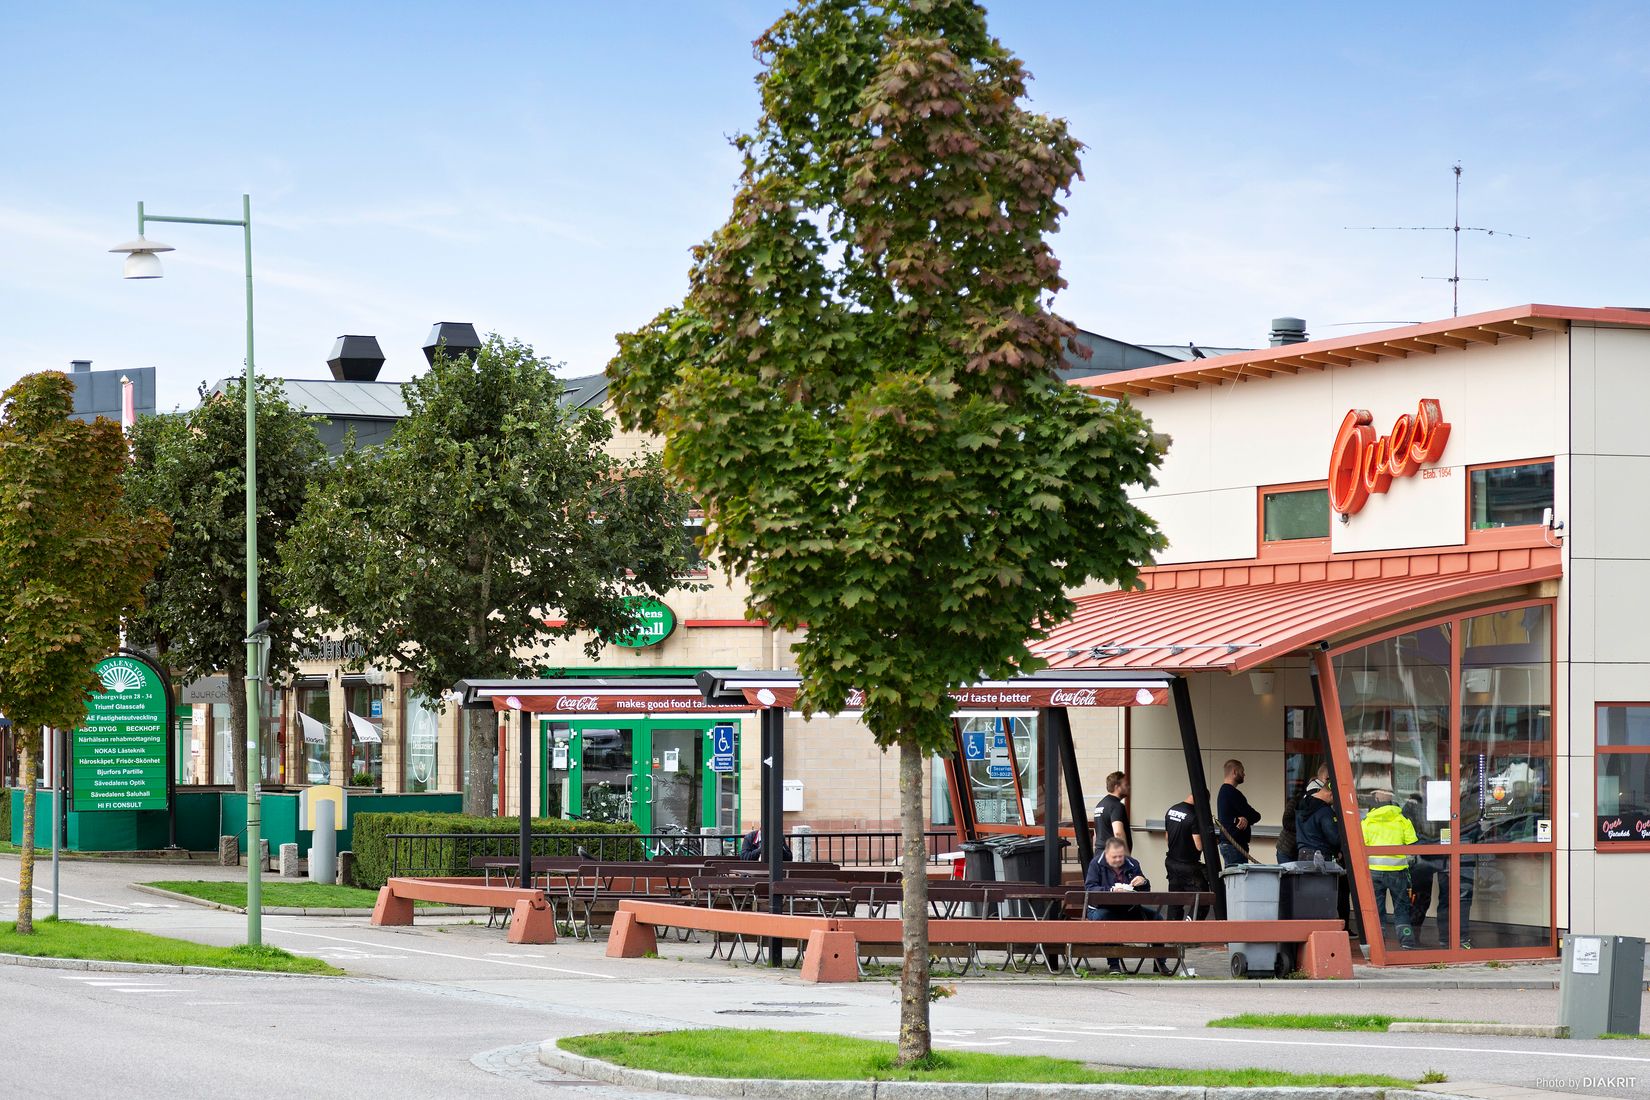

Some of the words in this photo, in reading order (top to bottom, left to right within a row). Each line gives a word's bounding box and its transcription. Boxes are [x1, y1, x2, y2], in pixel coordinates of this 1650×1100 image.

[1328, 399, 1451, 514] Oves
[133, 666, 147, 687] TORG
[556, 696, 600, 711] Coca-Cola
[616, 700, 645, 708] makes
[647, 700, 669, 711] good
[671, 699, 691, 708] food
[971, 693, 997, 703] taste
[1000, 692, 1031, 703] better
[1051, 689, 1099, 706] Coca-Cola
[129, 779, 146, 787] Optik
